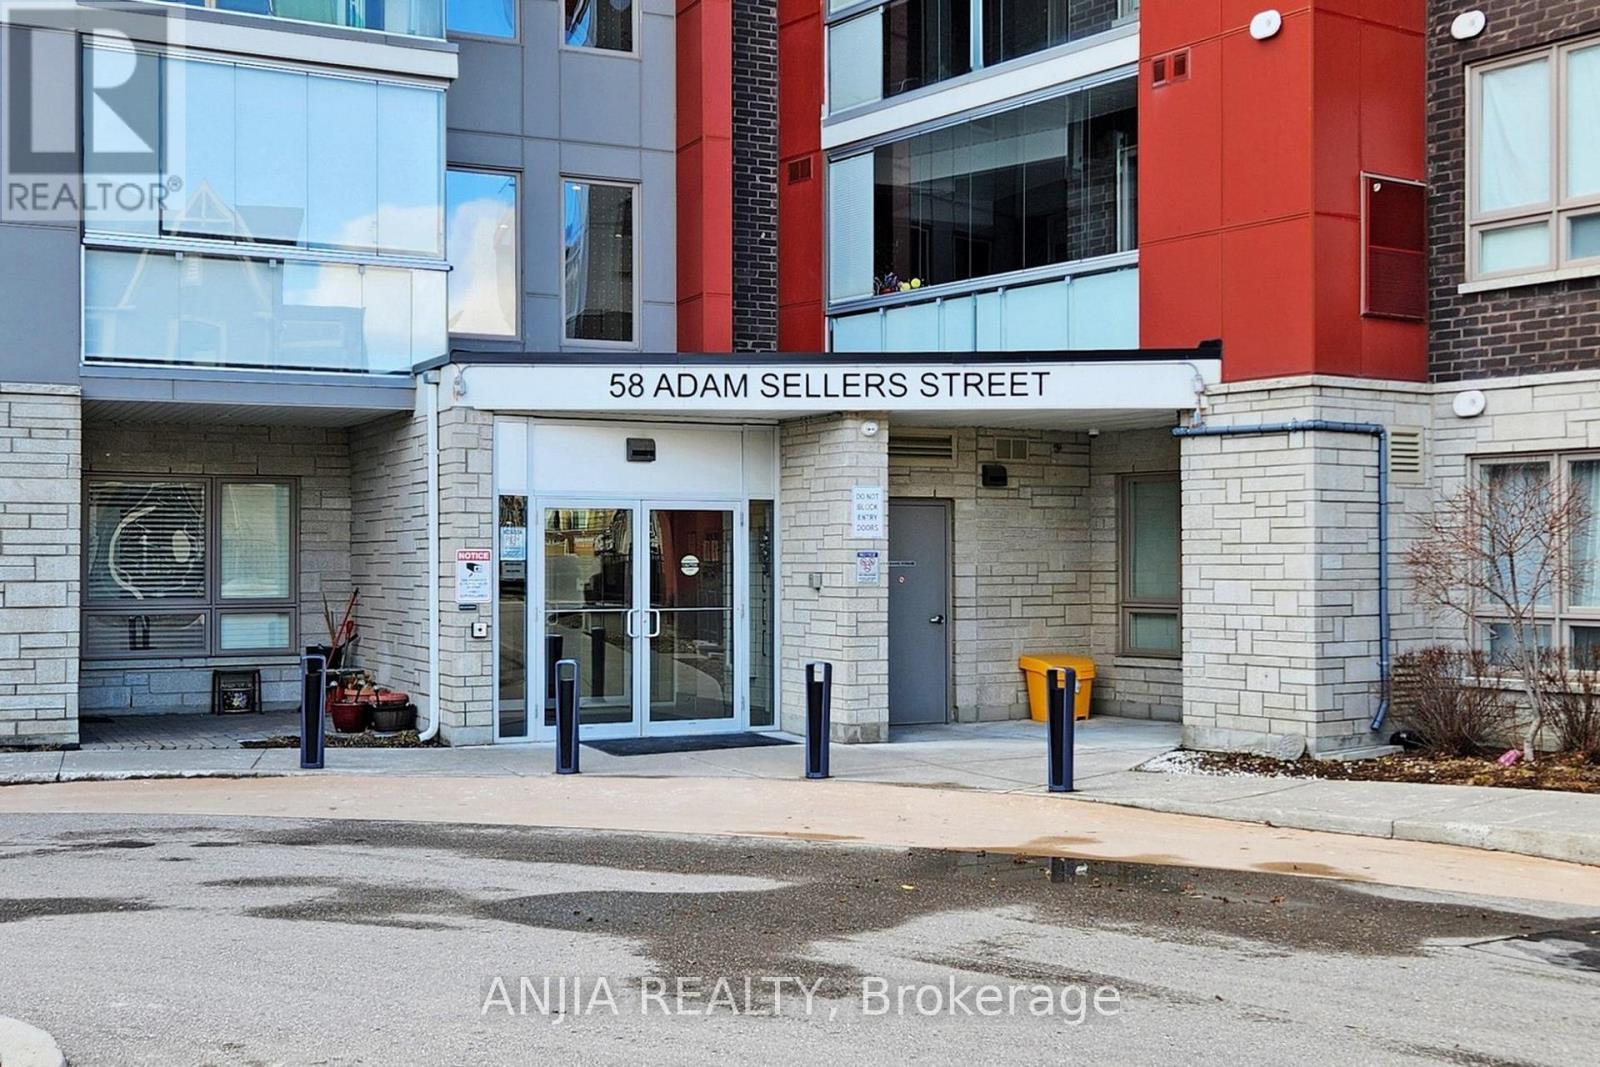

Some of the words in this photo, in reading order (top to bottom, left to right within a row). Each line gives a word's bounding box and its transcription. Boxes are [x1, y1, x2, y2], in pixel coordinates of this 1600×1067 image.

[609, 373, 644, 398] 58
[653, 373, 748, 398] ADAM
[760, 372, 908, 398] SELLERS
[920, 371, 1051, 397] STREET
[857, 524, 879, 532] DOORS
[458, 552, 489, 560] NOTICE
